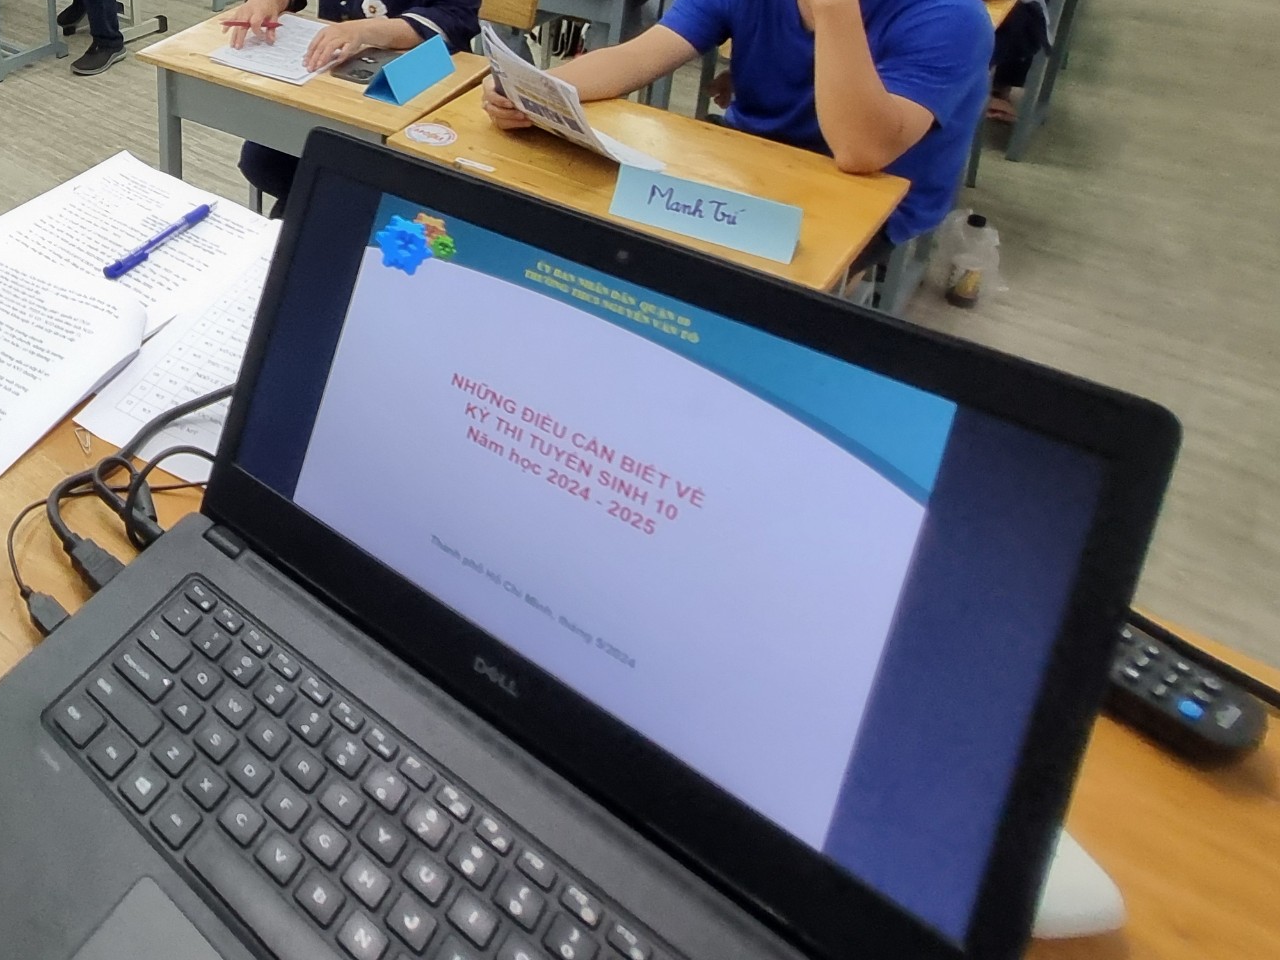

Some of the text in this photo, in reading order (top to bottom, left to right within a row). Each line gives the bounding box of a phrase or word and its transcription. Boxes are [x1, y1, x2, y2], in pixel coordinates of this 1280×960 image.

[451, 372, 517, 415] NHỮNG
[496, 416, 524, 442] THI
[597, 470, 648, 506] SINH
[655, 498, 679, 521] 10
[508, 447, 543, 474] học
[546, 468, 591, 501] 2024
[607, 500, 657, 536] 2025
[473, 656, 519, 698] DELL
